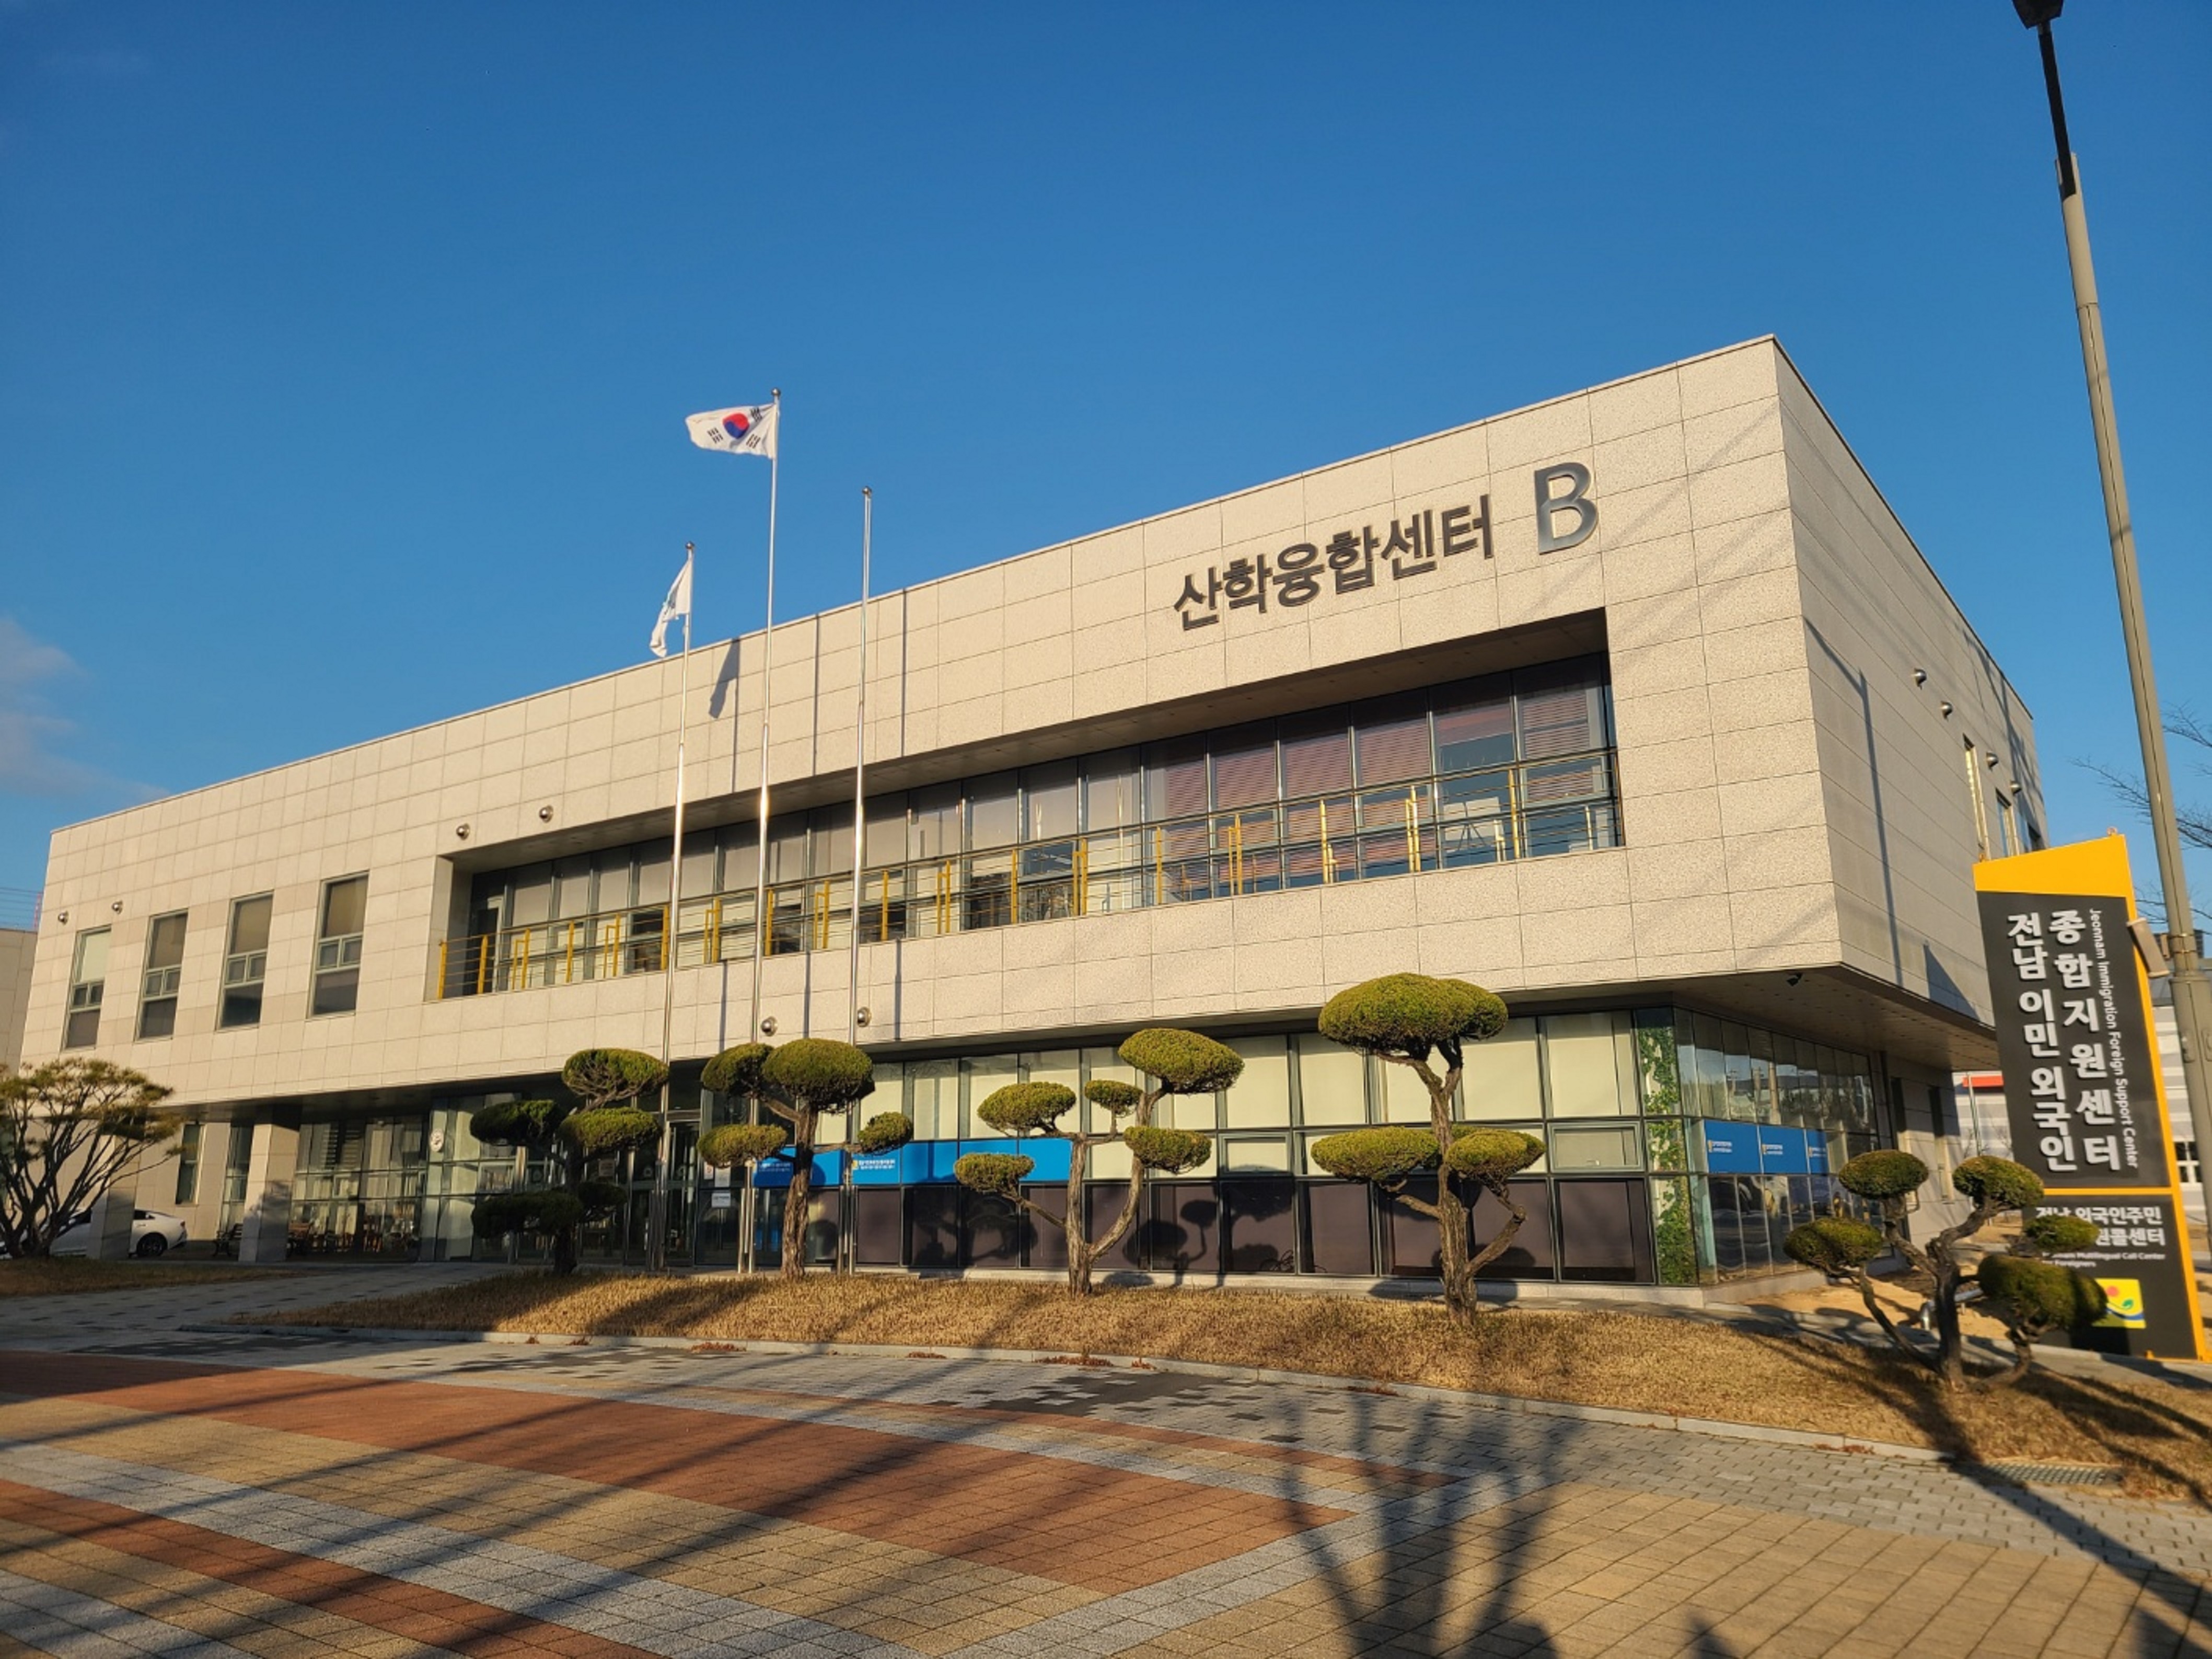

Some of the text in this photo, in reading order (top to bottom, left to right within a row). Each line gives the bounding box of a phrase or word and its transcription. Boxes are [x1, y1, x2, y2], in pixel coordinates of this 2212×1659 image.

[1173, 462, 1599, 631] 산학융합센터 B
[2008, 912, 2077, 1171] 전남 이민 외국인
[2048, 909, 2121, 1171] 종합지원센터
[2089, 908, 2139, 1169] Jeonnam Immigration Foreign Support Center
[2075, 1206, 2163, 1225] 외국인주민
